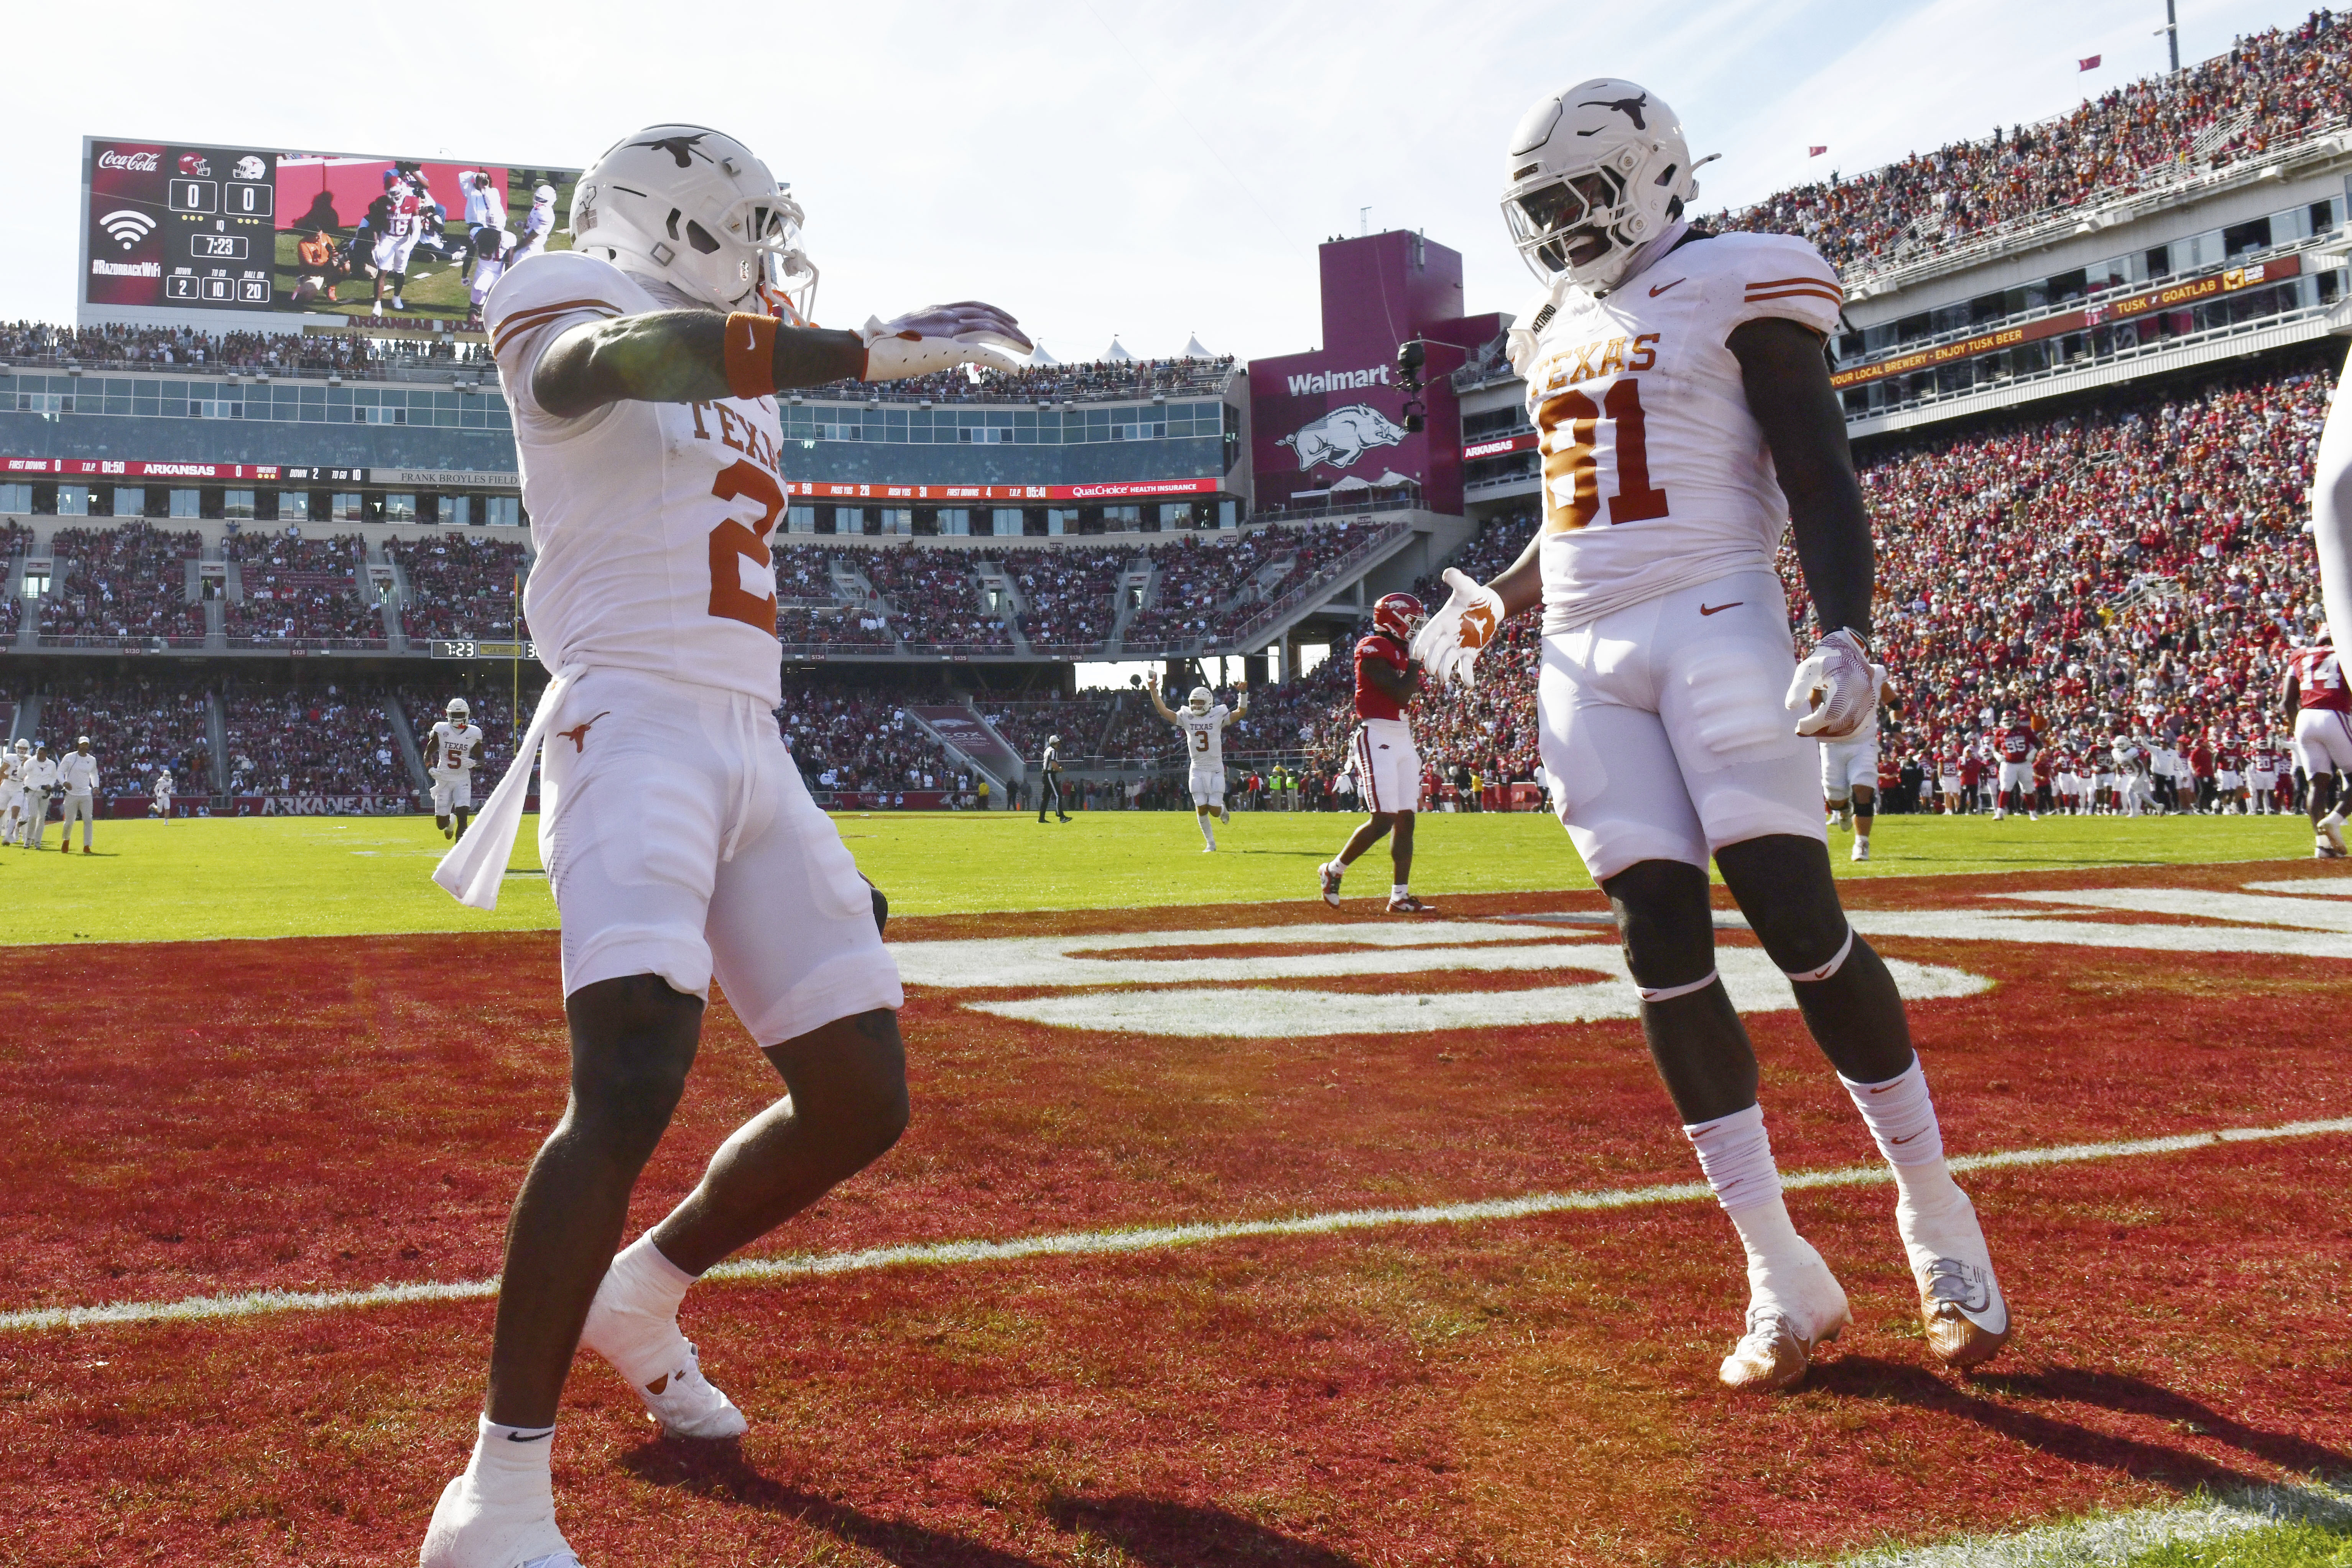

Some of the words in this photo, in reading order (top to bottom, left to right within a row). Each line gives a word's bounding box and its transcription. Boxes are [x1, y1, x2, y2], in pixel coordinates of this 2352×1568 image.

[98, 150, 161, 172] Coca-Cola
[188, 184, 199, 207] 0
[243, 188, 254, 211] 0
[216, 220, 225, 232] 1Q
[206, 237, 233, 255] 7:23
[175, 267, 192, 275] DOWN
[212, 268, 218, 277] TO
[218, 269, 226, 277] GO
[243, 270, 255, 279] BALL
[256, 271, 264, 279] ON
[179, 280, 187, 296] 2
[213, 283, 224, 297] 10
[247, 283, 261, 299] 20
[2117, 298, 2147, 314] TUSK
[2161, 280, 2216, 303] GOATLAB
[347, 316, 434, 331] ARKANSAS
[1532, 304, 1556, 335] NXTRND
[1855, 365, 1883, 380] LOCAL
[1884, 354, 1927, 373] BREWERY
[1935, 344, 1966, 361] ENJOY
[1968, 337, 1994, 352] TUSK
[1996, 329, 2023, 345] BEER
[1530, 333, 1661, 399] TEXAS
[1287, 364, 1390, 396] Walmart
[1465, 440, 1513, 458] ARKANSAS
[1539, 378, 1669, 535] 81
[8, 460, 23, 469] FIRST
[25, 461, 46, 470] DOWNS
[54, 459, 61, 472] 0
[102, 461, 125, 474] 01:50
[143, 464, 215, 476] ARKANSAS
[236, 465, 242, 477] 0
[289, 469, 308, 478] DOWN
[313, 468, 319, 479] 2
[332, 470, 339, 479] TO
[339, 471, 347, 479] GO
[353, 469, 361, 481] 10
[401, 472, 436, 482] FRANK
[439, 474, 485, 484] BROYLES
[489, 476, 518, 484] FIELD
[802, 483, 812, 494] 59
[831, 486, 843, 494] PASS
[844, 486, 853, 495] YDS
[860, 485, 870, 496] 28
[888, 487, 901, 496] RUSH
[902, 488, 911, 497] YDS
[919, 487, 927, 498] 31
[947, 488, 960, 497] FIRST
[961, 488, 979, 497] DOWNS
[985, 486, 992, 497] 4
[1026, 486, 1046, 498] 05:41
[1157, 484, 1196, 492] INSURANCE
[708, 458, 785, 641] 2
[444, 642, 474, 657] 7:23
[2299, 653, 2340, 691] 14
[444, 741, 468, 752] TEXAS
[1195, 731, 1209, 752] 3
[447, 750, 461, 769] 5
[261, 796, 386, 814] ARKANSAS
